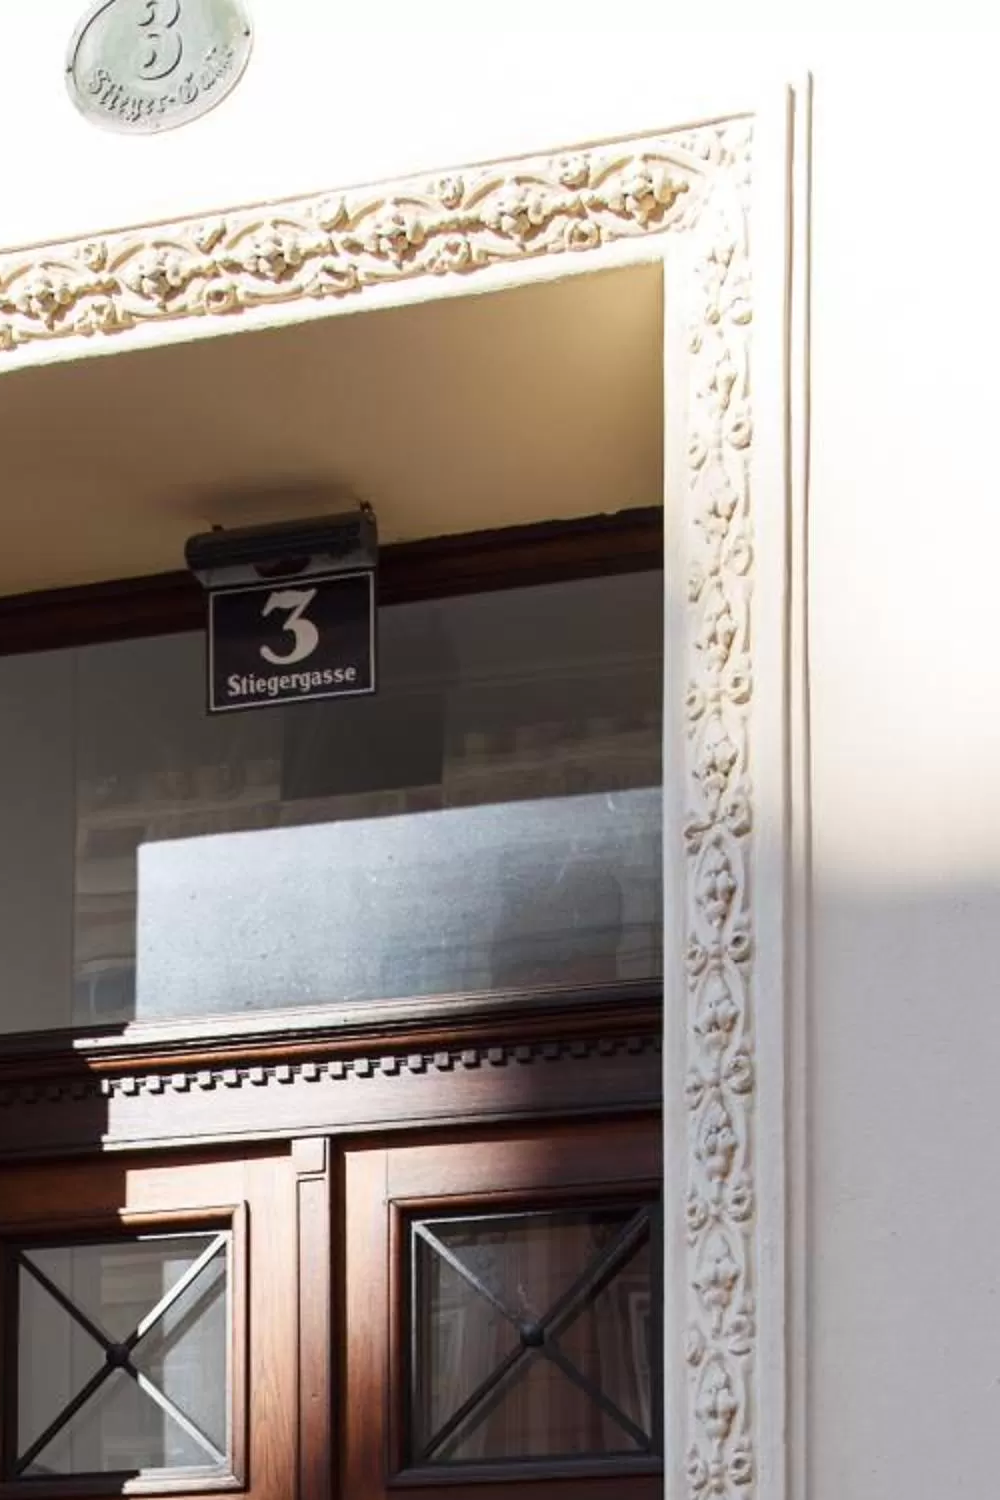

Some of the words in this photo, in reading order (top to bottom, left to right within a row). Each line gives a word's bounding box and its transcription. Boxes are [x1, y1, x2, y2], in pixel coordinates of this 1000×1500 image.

[132, 0, 183, 81] 3
[260, 588, 319, 665] 3
[227, 667, 356, 697] Stiegergasse
